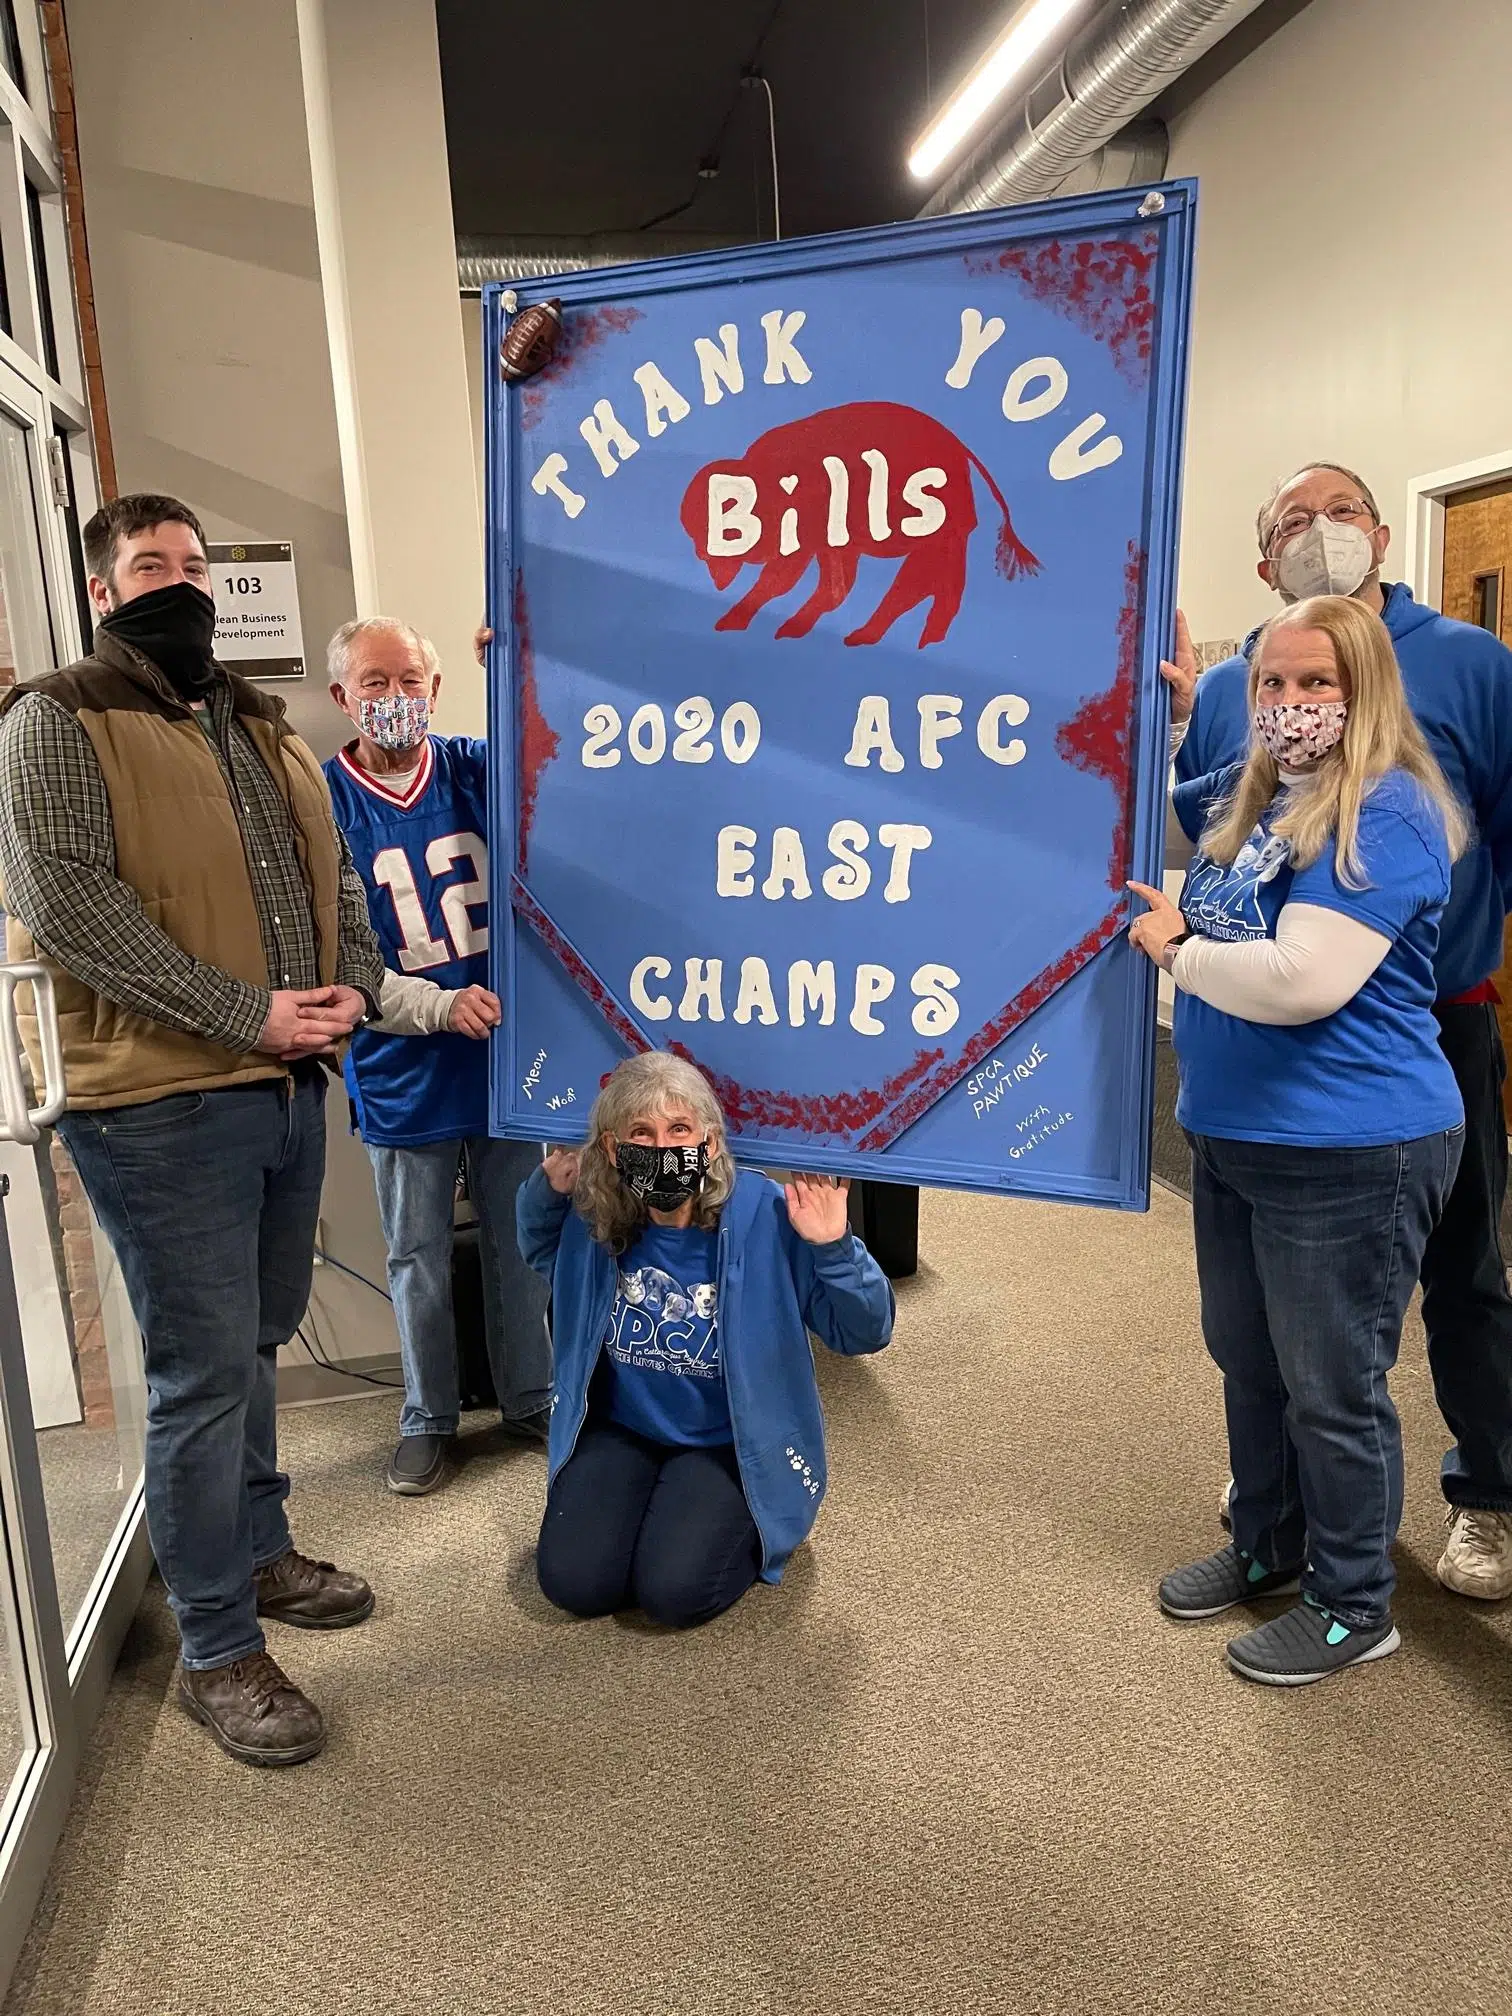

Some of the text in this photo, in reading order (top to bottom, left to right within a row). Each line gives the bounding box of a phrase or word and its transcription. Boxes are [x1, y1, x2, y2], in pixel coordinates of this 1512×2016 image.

[531, 308, 1123, 518] THANK YOU
[707, 449, 947, 557] Bills
[225, 577, 262, 595] 103
[213, 628, 285, 640] Development
[216, 613, 287, 624] lean Business
[582, 694, 1029, 772] 2020 AFC
[717, 820, 932, 904] EAST
[372, 831, 488, 972] 12
[630, 957, 960, 1036] CHAMPS
[522, 1048, 547, 1100] Meow
[545, 1087, 577, 1110] Woof
[967, 1059, 1004, 1095] SPCA
[973, 1043, 1048, 1119] PAWTIQUE
[1009, 1112, 1074, 1158] Gratitude
